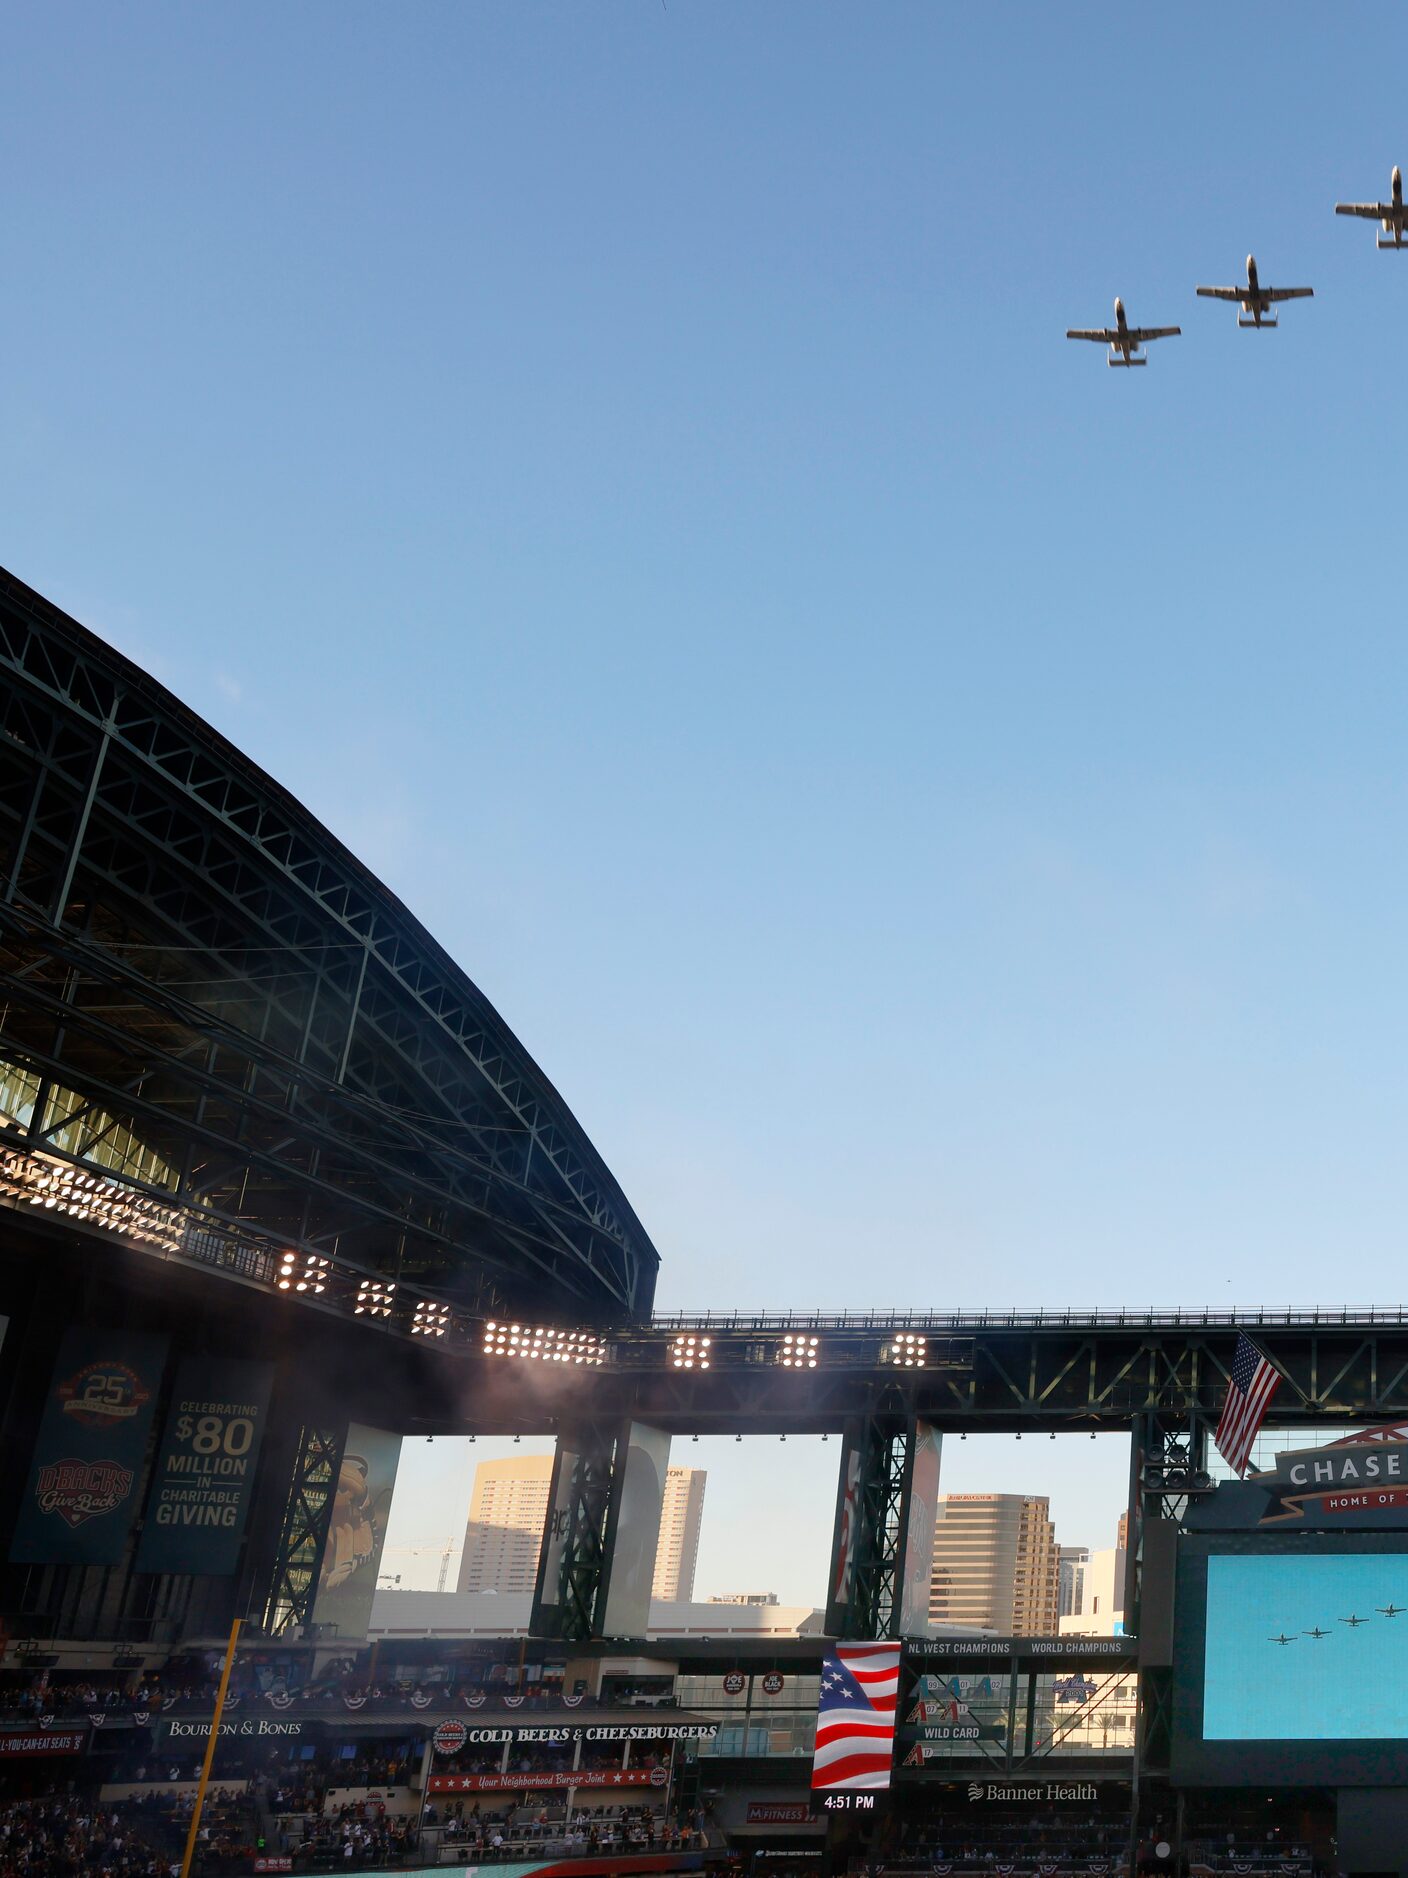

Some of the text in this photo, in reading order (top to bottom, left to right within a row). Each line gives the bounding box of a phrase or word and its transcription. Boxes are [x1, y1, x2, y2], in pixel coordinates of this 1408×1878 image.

[180, 1401, 258, 1416] CELEBRATING
[175, 1415, 254, 1456] $80
[166, 1455, 247, 1475] MILLION
[1289, 1454, 1401, 1486] CHASE
[36, 1466, 133, 1497] D-BACKS
[196, 1476, 212, 1488] IN
[160, 1488, 240, 1504] CHARITABLE
[1330, 1495, 1369, 1508] HOME
[1379, 1494, 1396, 1504] OF
[156, 1504, 237, 1527] GIVING
[908, 1643, 1010, 1653] NL WEST CHAMPIONS
[1031, 1642, 1122, 1653] WORLD CHAMPIONS
[241, 1721, 254, 1735] &
[469, 1729, 512, 1743] COLD
[517, 1728, 570, 1741] BEERS
[574, 1729, 583, 1740] &
[586, 1726, 718, 1740] CHEESEBURGERS
[924, 1728, 980, 1739] WILD CARD
[51, 1737, 71, 1749] SEATS
[478, 1773, 605, 1789] Your Neighborhood Burger Joint
[986, 1784, 1098, 1801] Banner Health
[824, 1796, 874, 1809] 4:51 PM
[763, 1810, 803, 1820] FITNESS
